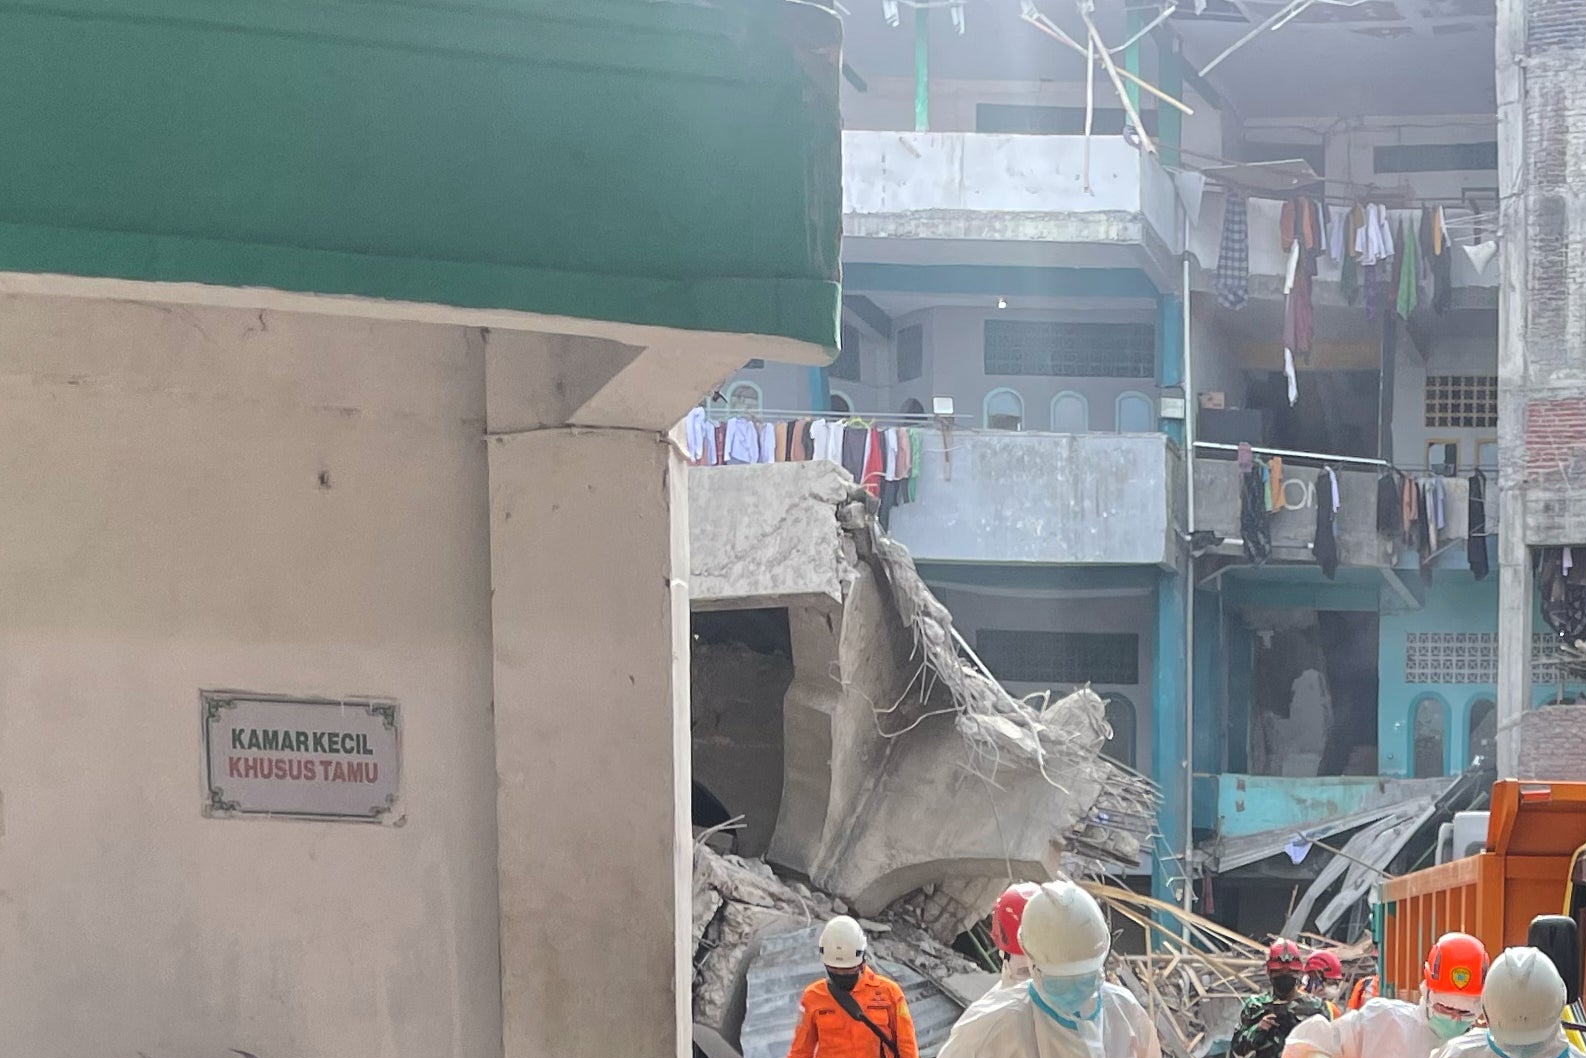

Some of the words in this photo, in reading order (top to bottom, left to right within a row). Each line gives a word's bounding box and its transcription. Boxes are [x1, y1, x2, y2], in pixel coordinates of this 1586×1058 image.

[231, 728, 309, 752] KAMAR
[313, 731, 374, 755] KECIL
[228, 756, 317, 780] KHUSUS
[319, 760, 379, 783] TAMU
